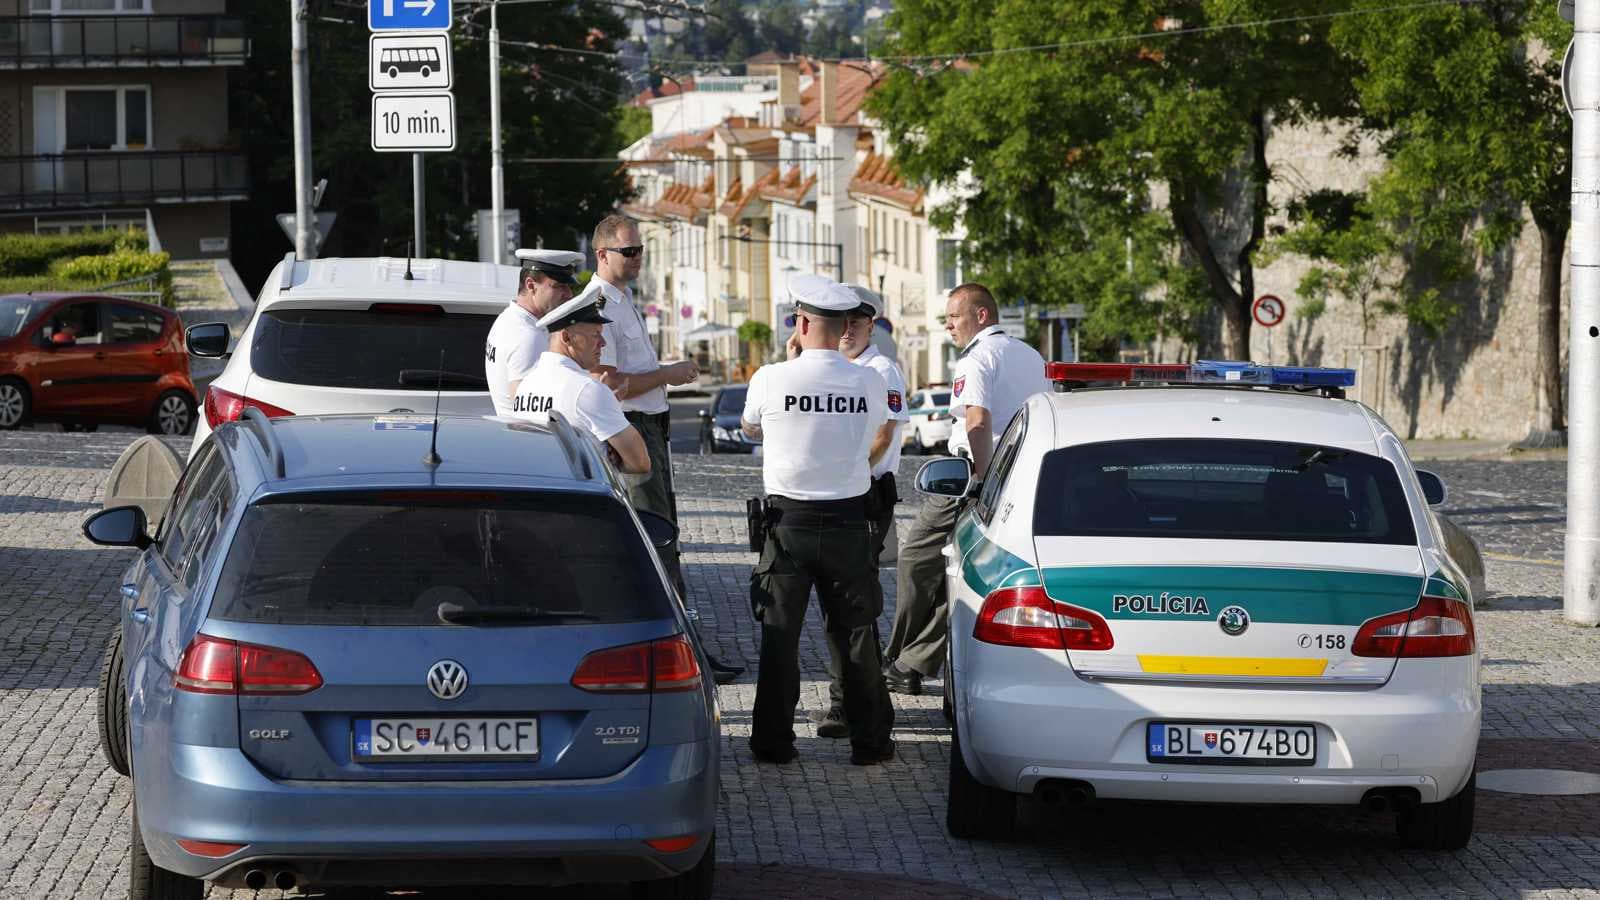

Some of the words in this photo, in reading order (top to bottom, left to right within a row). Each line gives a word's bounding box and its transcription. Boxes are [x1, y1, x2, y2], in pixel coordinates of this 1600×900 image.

[382, 111, 400, 134] 10
[407, 109, 446, 134] min.
[513, 392, 553, 413] OLÍCIA
[784, 393, 868, 413] POLÍCIA
[1112, 591, 1210, 615] POLÍCIA
[1315, 634, 1346, 650] 158
[249, 729, 289, 739] GOLF
[375, 721, 414, 752] SC
[433, 721, 533, 753] 461CF
[1151, 744, 1162, 753] SK
[1168, 727, 1202, 755] BL
